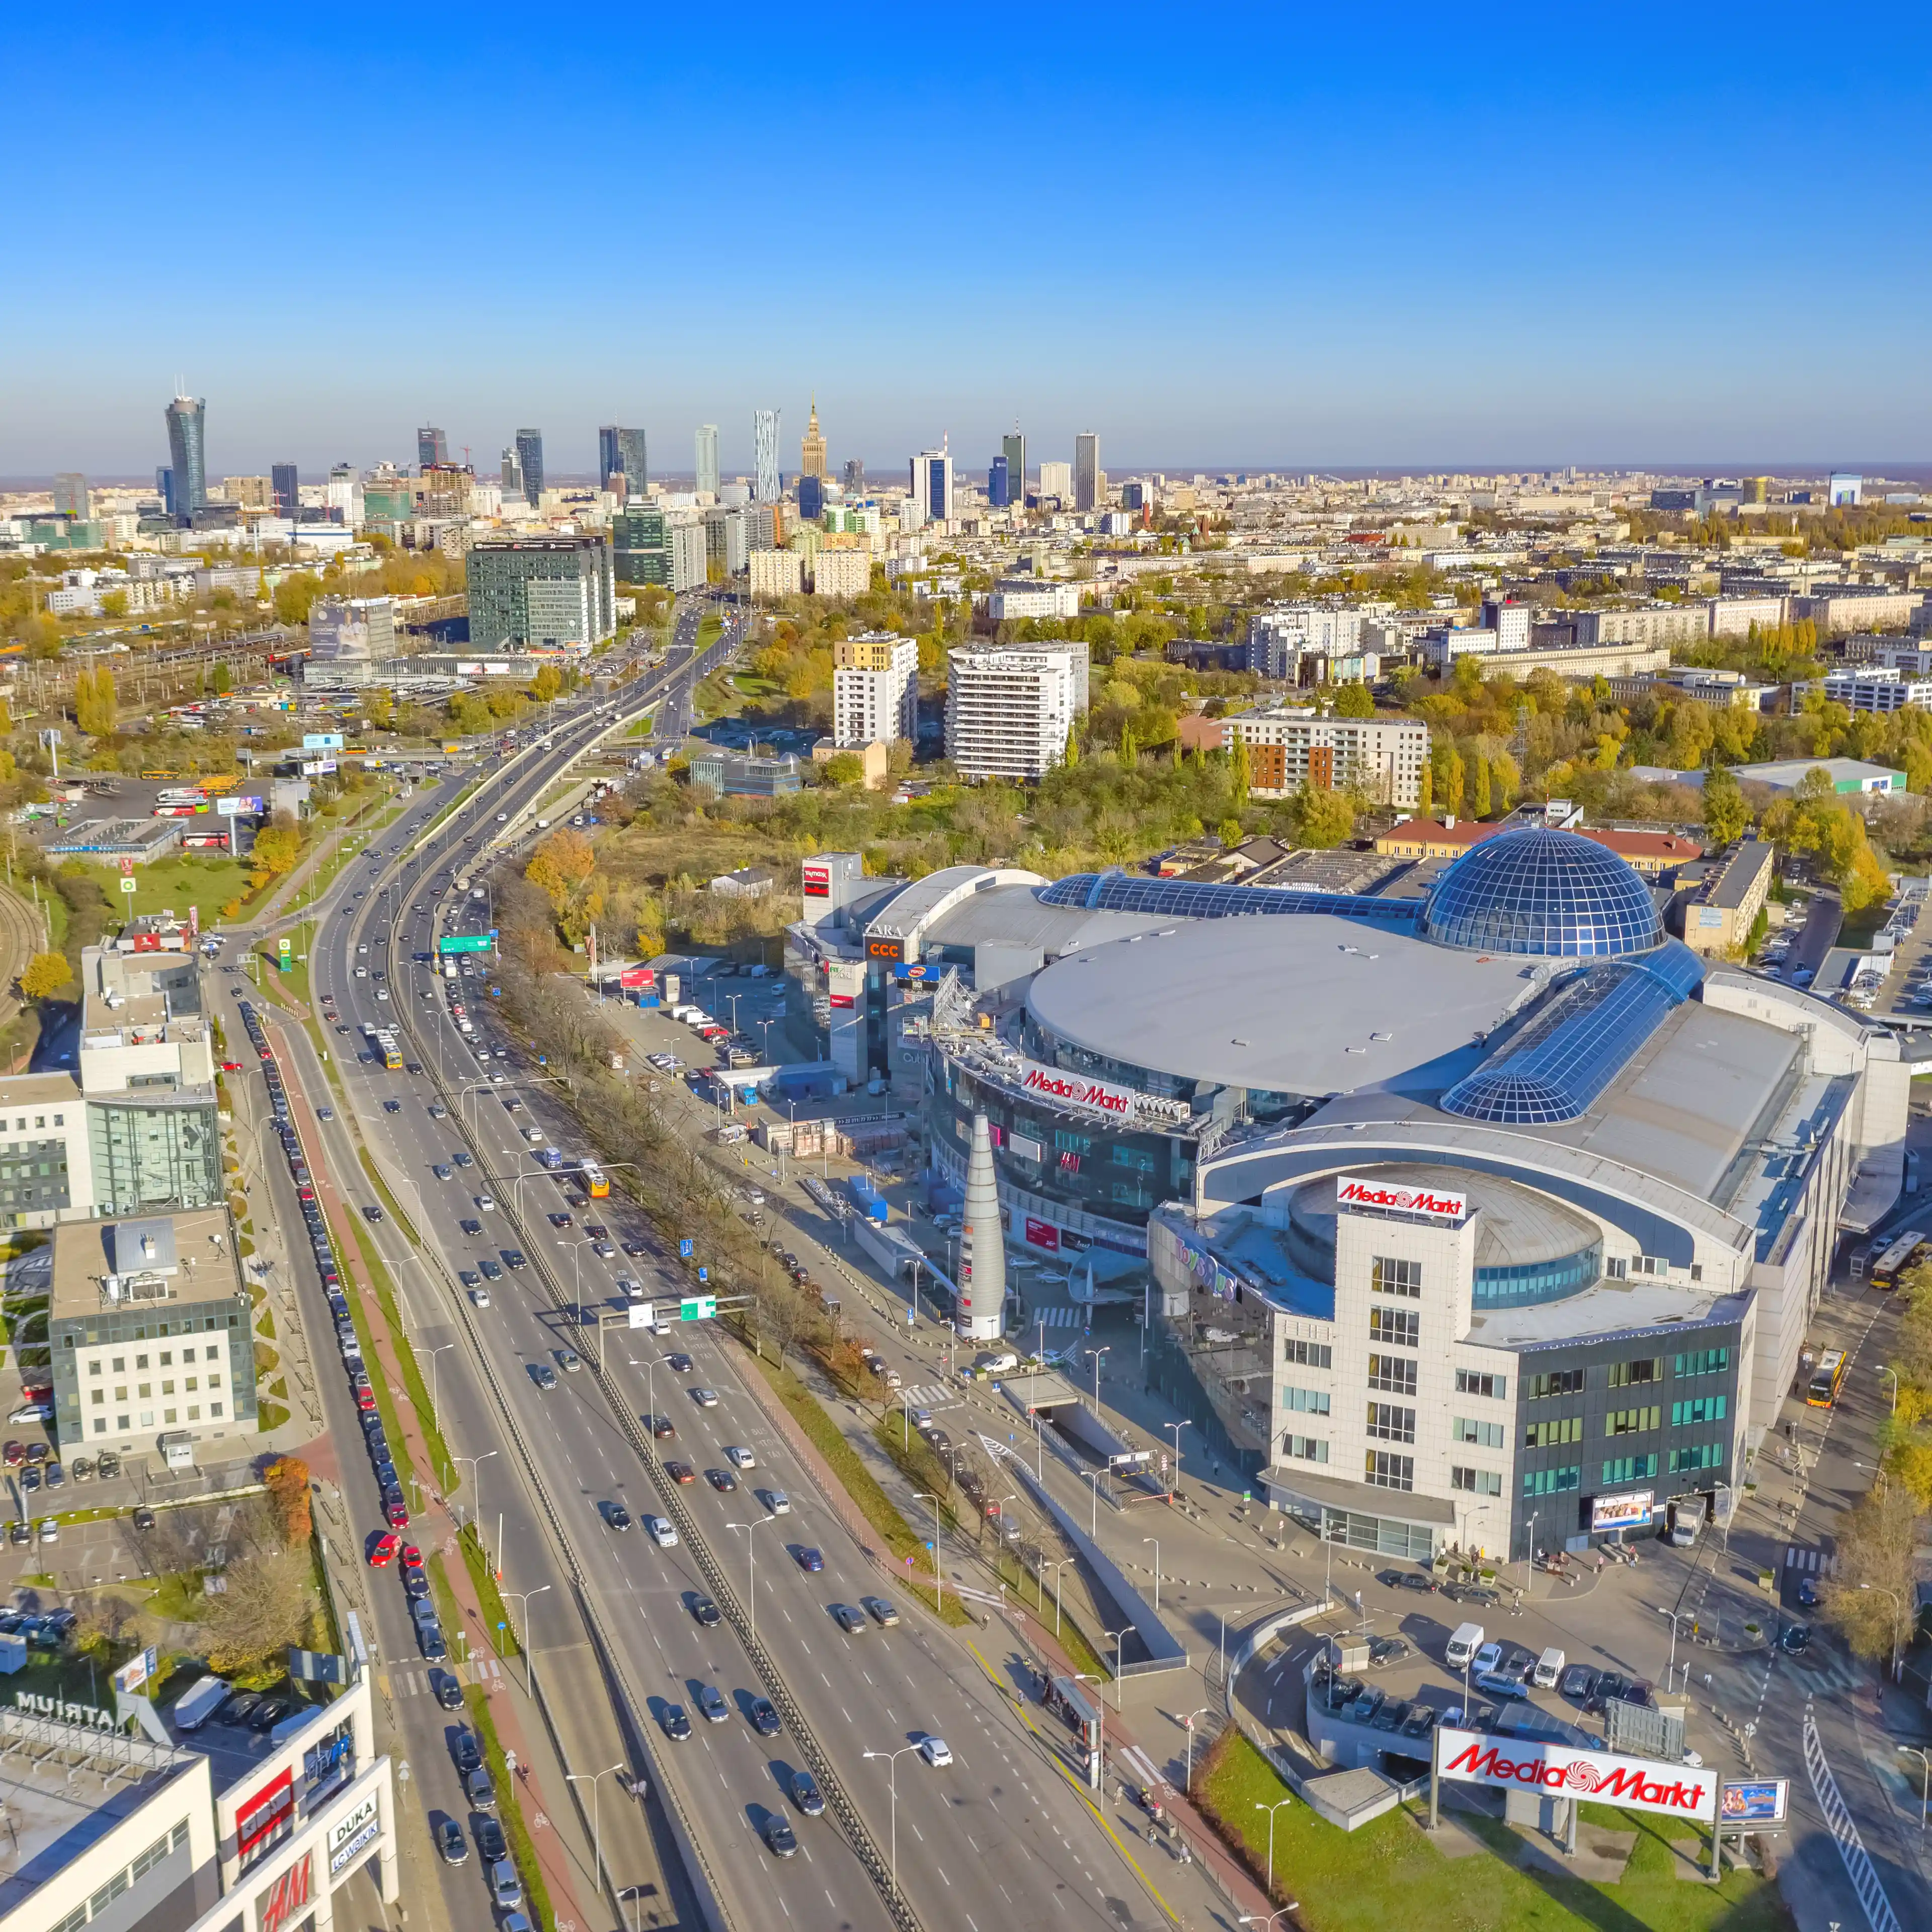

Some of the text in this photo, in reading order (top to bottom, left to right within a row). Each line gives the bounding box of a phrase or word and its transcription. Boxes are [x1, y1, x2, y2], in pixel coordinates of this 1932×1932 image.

[870, 943, 898, 957] CCC
[1023, 1070, 1129, 1113] Media Markt
[1338, 1183, 1463, 1215] Media Markt
[1444, 1743, 1706, 1810] Media Markt
[336, 1802, 373, 1843] DUKA
[333, 1854, 345, 1870] LC
